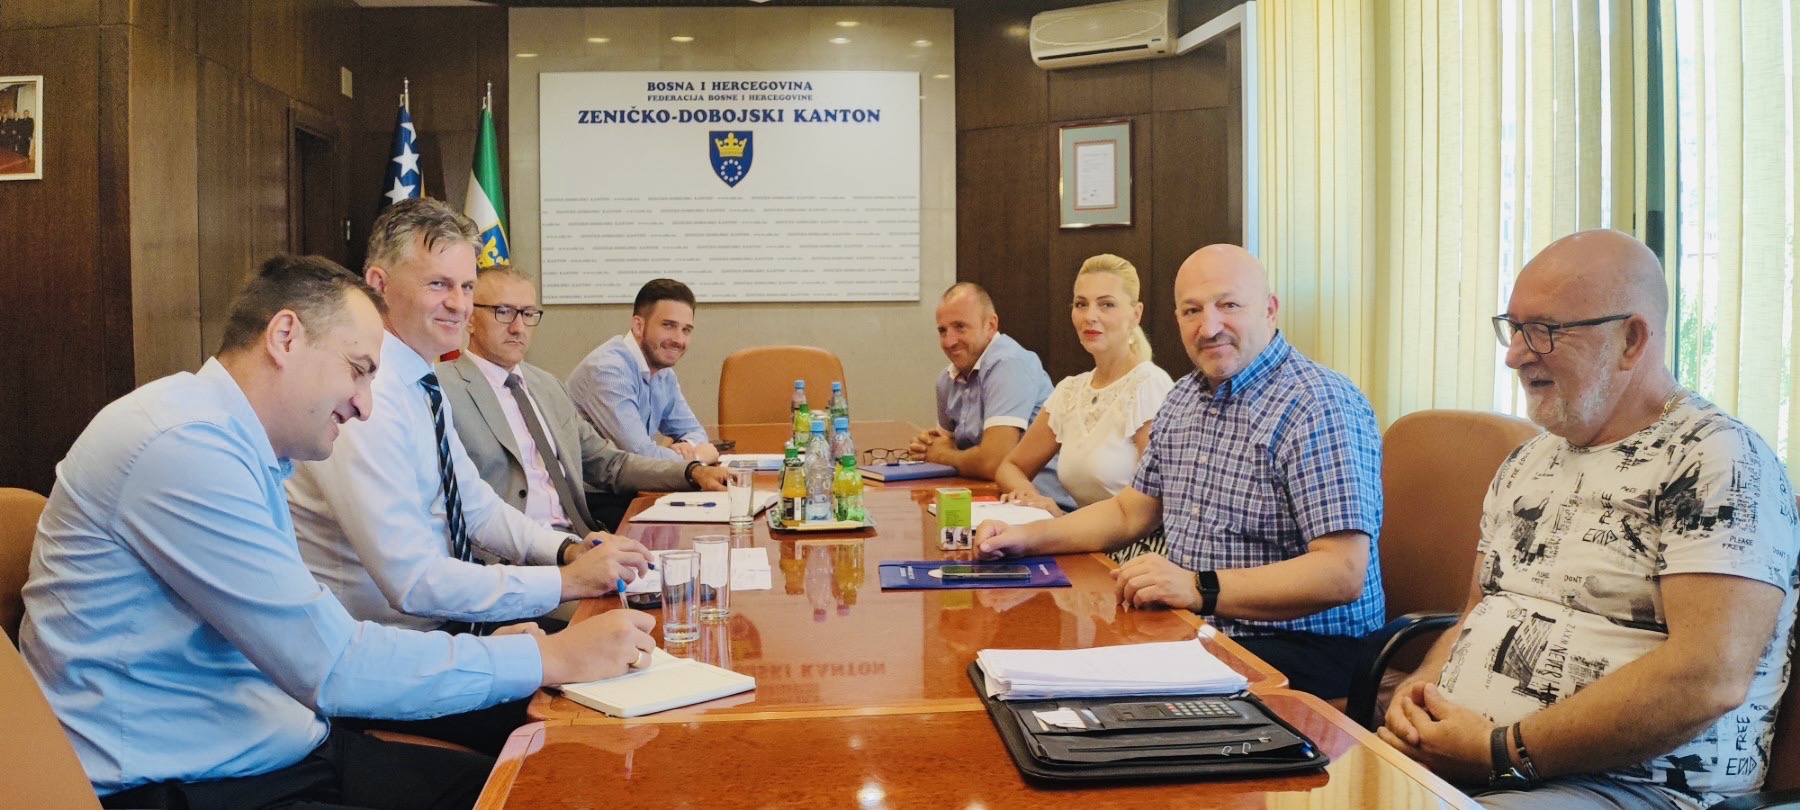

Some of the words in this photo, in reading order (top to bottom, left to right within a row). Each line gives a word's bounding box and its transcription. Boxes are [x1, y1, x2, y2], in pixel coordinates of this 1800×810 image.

[647, 81, 695, 91] BOSNA
[700, 81, 706, 91] I
[712, 81, 813, 91] HERCEGOVINA
[647, 94, 704, 102] FEDERACIJA
[749, 93, 813, 101] HERCEGOVINE
[577, 105, 784, 124] ZENIČKO-DOBOJSKI
[793, 108, 881, 123] KANTON
[1598, 491, 1615, 525] FREE
[1729, 535, 1754, 547] PLEASE
[1563, 575, 1583, 584] DONT
[1736, 715, 1750, 751] FREE
